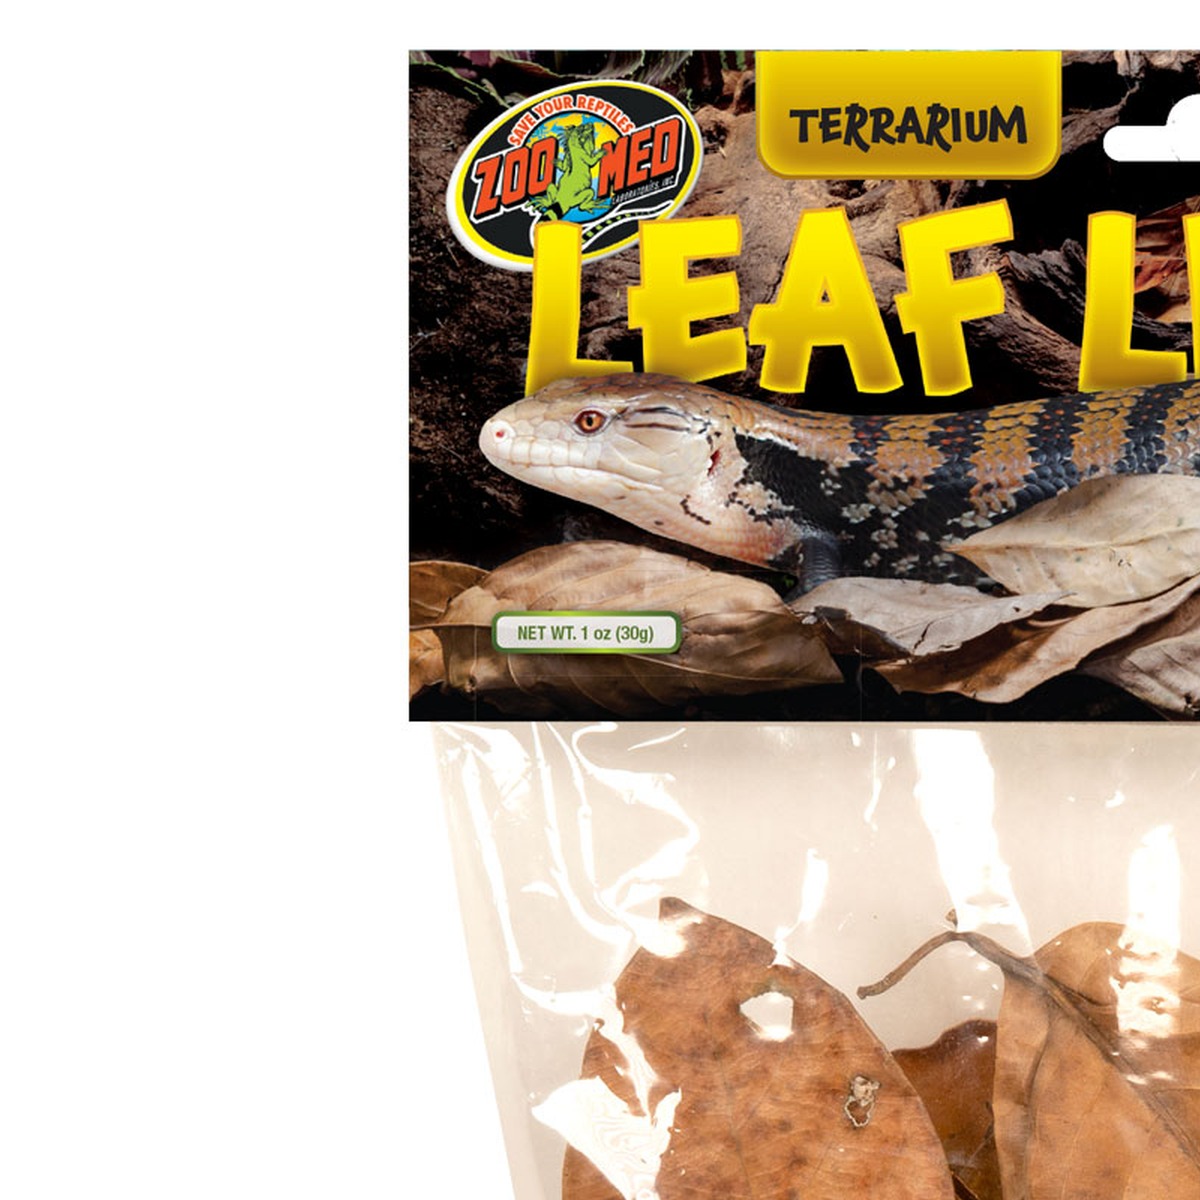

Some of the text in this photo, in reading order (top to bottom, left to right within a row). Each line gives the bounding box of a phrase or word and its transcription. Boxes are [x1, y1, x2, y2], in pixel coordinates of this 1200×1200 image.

[509, 95, 636, 147] SAVE YOUR REPTILES
[789, 103, 1028, 153] TERRARIUM
[475, 118, 680, 216] ZOO MED
[524, 198, 1014, 397] LEAF
[517, 625, 654, 644] NET WT. 1 oz (30g)
